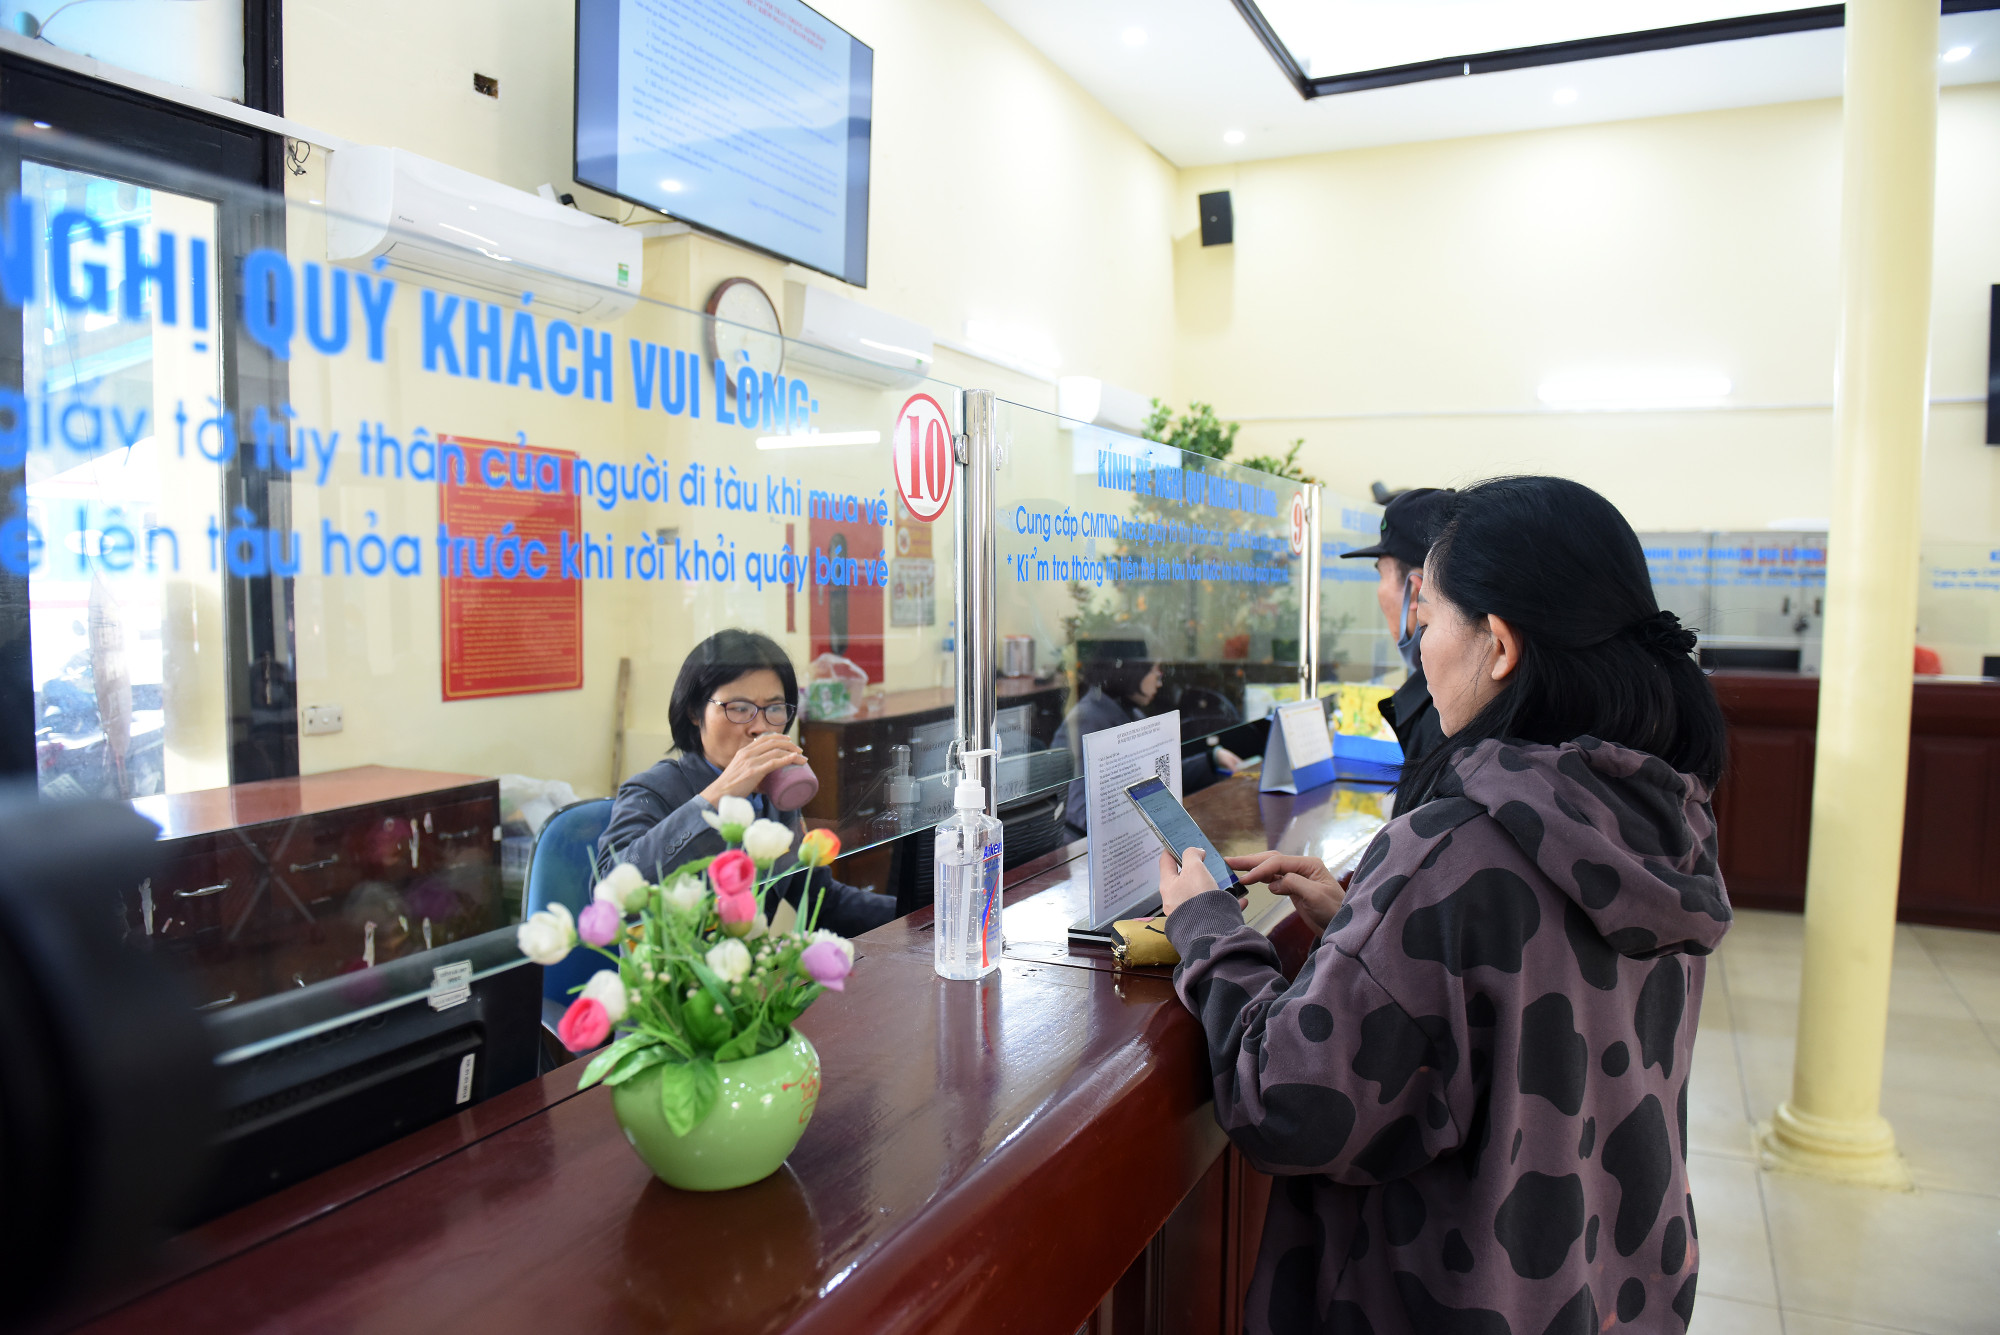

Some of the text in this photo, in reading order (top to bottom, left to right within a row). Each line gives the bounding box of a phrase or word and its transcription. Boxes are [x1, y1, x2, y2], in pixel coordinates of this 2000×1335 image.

[242, 249, 396, 363] QUÝ
[421, 288, 613, 403] KHÁCH
[629, 338, 700, 419] VUI
[715, 349, 820, 436] LÒNG:
[173, 395, 236, 464] tờ
[252, 402, 339, 487] tùy
[357, 420, 466, 486] thân
[480, 431, 561, 493] của
[573, 453, 669, 511] người
[679, 462, 706, 507] đi
[714, 465, 758, 512] tàu
[766, 474, 801, 516] khi
[808, 490, 859, 524] mua
[864, 488, 893, 527] vé.
[906, 415, 946, 502] 10
[1098, 443, 1131, 492] KÍNH
[1155, 462, 1184, 507] NGHỊ
[1185, 466, 1207, 507] QUÝ
[1208, 471, 1239, 511] KHÁCH
[77, 506, 179, 573] lên
[207, 506, 301, 579] tàu
[321, 510, 421, 577] hỏa
[437, 522, 548, 579] trước
[561, 530, 614, 580] khi
[624, 531, 665, 581] rời
[675, 533, 736, 582] khỏi
[815, 545, 859, 586] bán
[864, 549, 889, 587] vé
[1016, 505, 1051, 542] Cung
[1055, 506, 1078, 542] cấp
[1081, 511, 1119, 539] CMTND
[1121, 515, 1147, 546] hoặc
[1294, 504, 1302, 544] 9
[1052, 554, 1069, 582] tra
[1072, 555, 1104, 587] thông
[1105, 556, 1118, 581] tin
[1120, 555, 1139, 581] trên
[1158, 556, 1171, 581] lên
